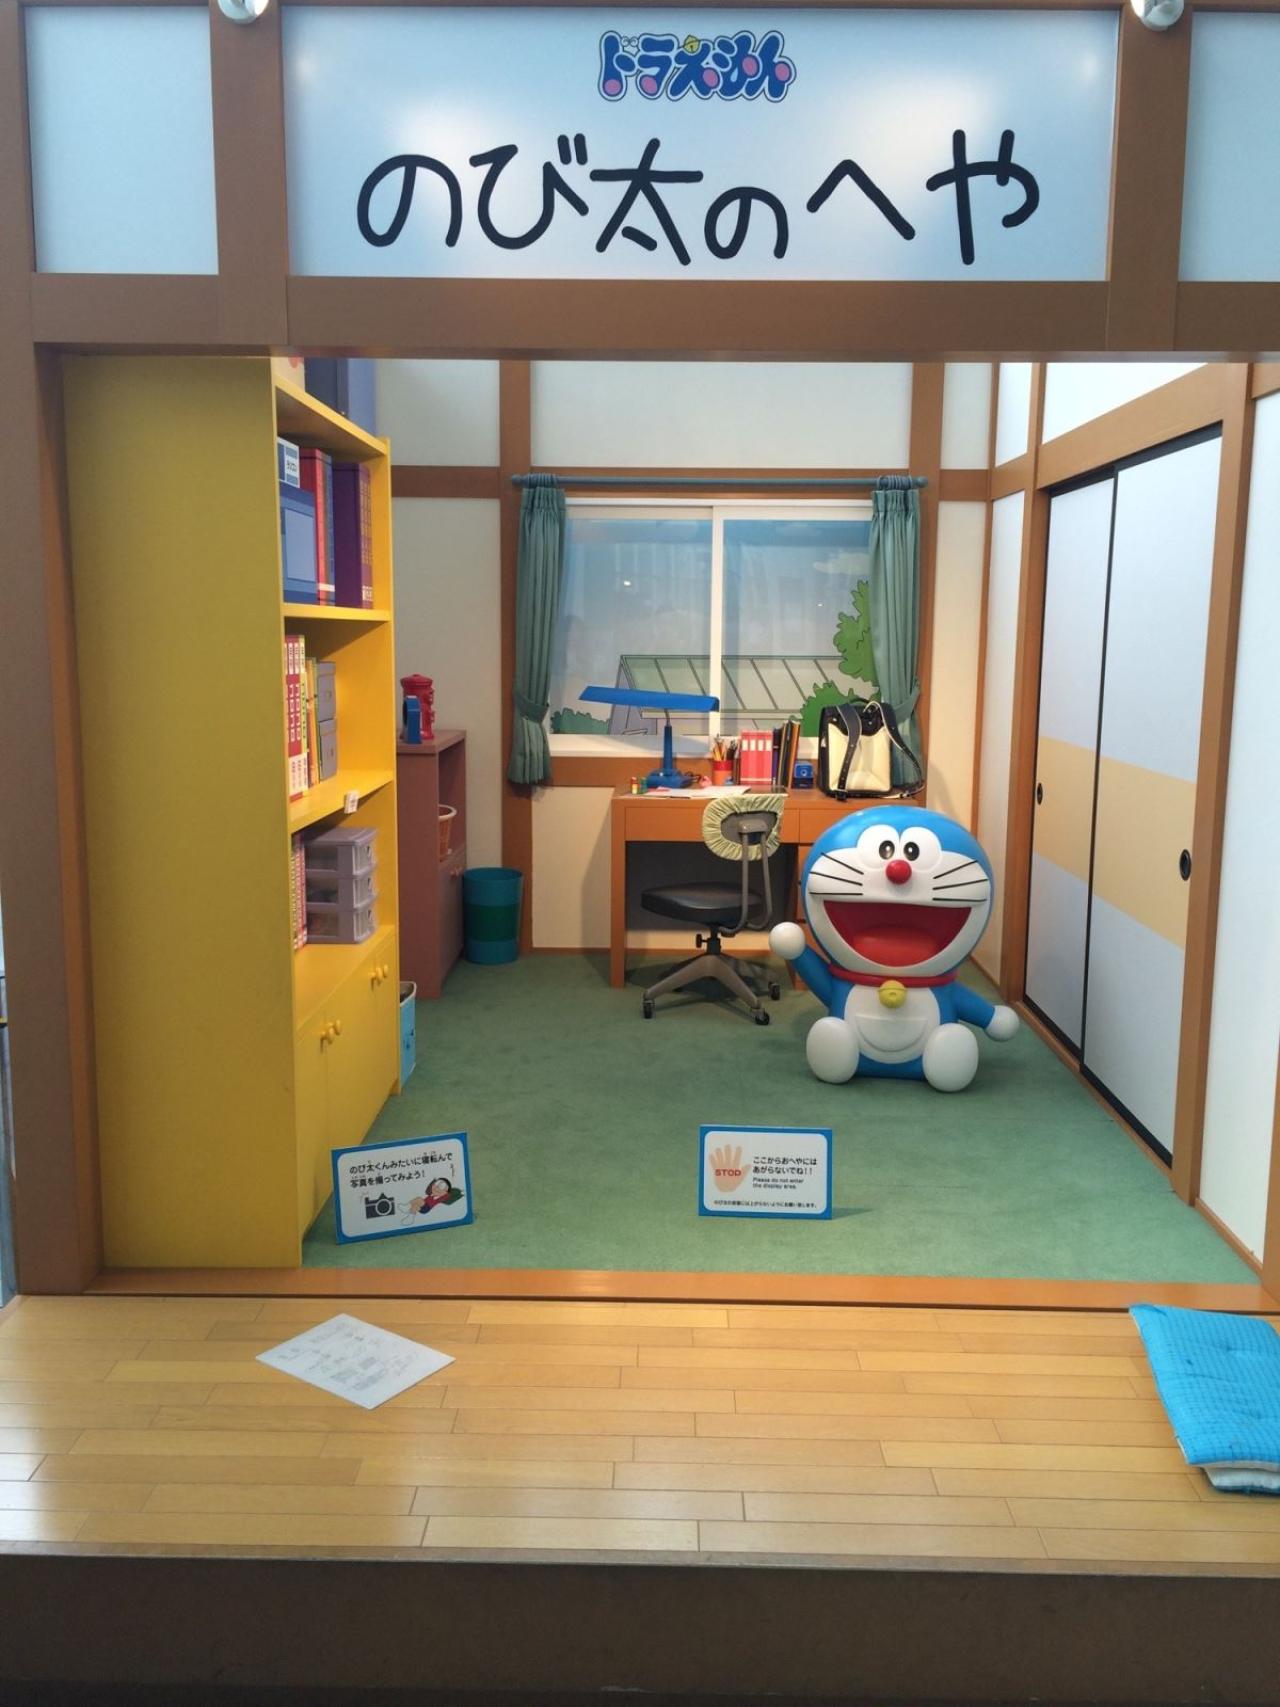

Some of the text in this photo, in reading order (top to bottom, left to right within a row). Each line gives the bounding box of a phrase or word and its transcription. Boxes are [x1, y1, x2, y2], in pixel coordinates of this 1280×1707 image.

[599, 30, 796, 103] ドラえもん
[357, 133, 1040, 266] のび太のへや
[753, 1157, 817, 1165] ここからおへやには
[715, 1168, 742, 1177] STOP
[753, 1166, 812, 1175] あがらないでね!!
